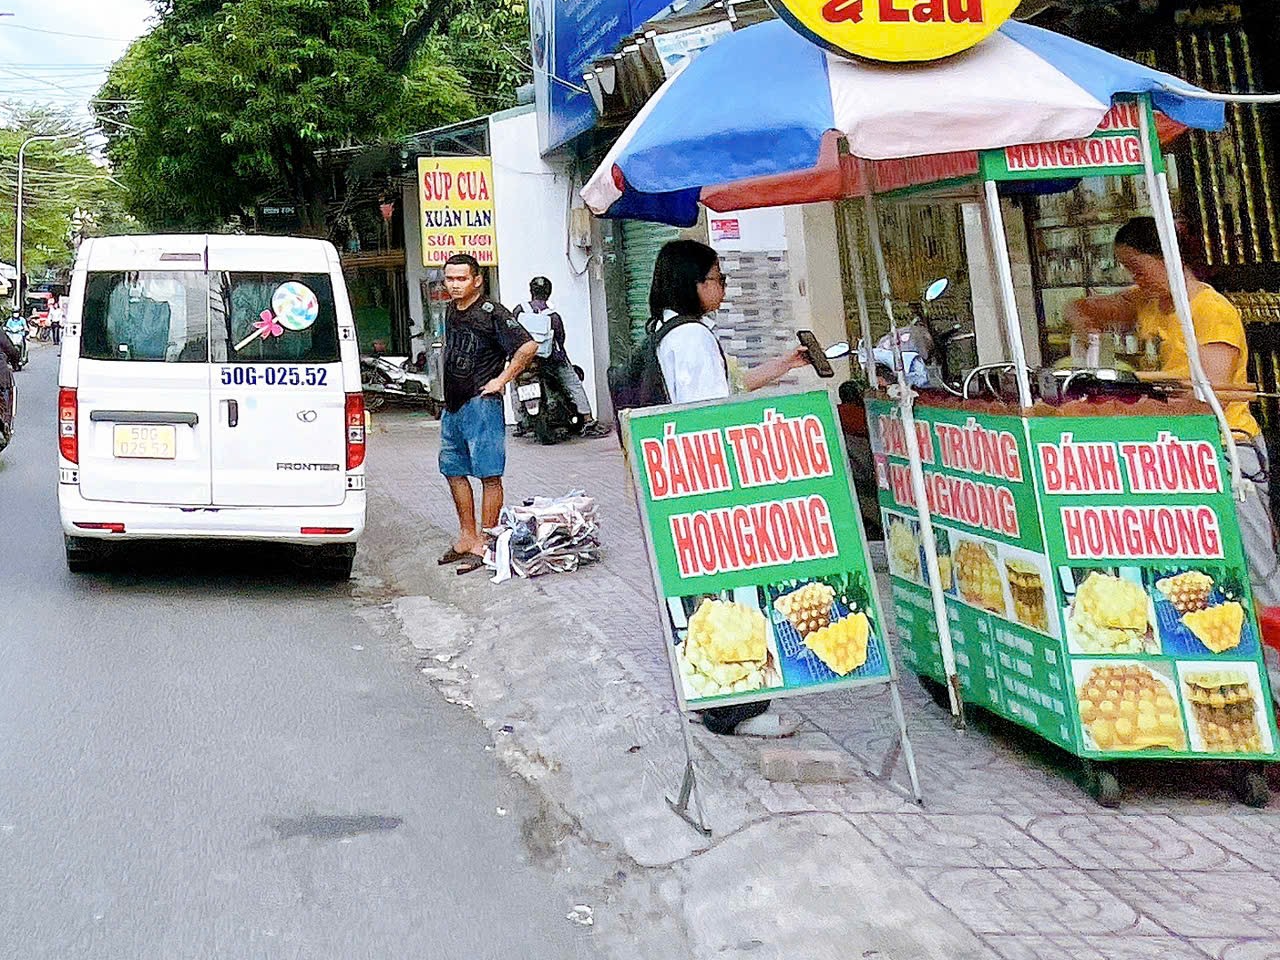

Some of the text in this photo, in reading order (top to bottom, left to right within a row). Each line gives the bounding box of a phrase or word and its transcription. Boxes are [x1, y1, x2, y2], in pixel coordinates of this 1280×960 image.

[423, 162, 490, 201] SÚP CUA
[425, 205, 492, 227] XUÂN LAN
[220, 366, 328, 387] 50G-025.52
[131, 427, 159, 441] 50G
[642, 410, 830, 498] BÁNH TRỨNG
[935, 418, 1022, 479] TRỨNG
[276, 462, 340, 472] FRONTIER
[1040, 433, 1220, 493] BÁNH TRỨNG
[671, 496, 835, 575] HONGKONG
[1063, 507, 1221, 557] HONGKONG
